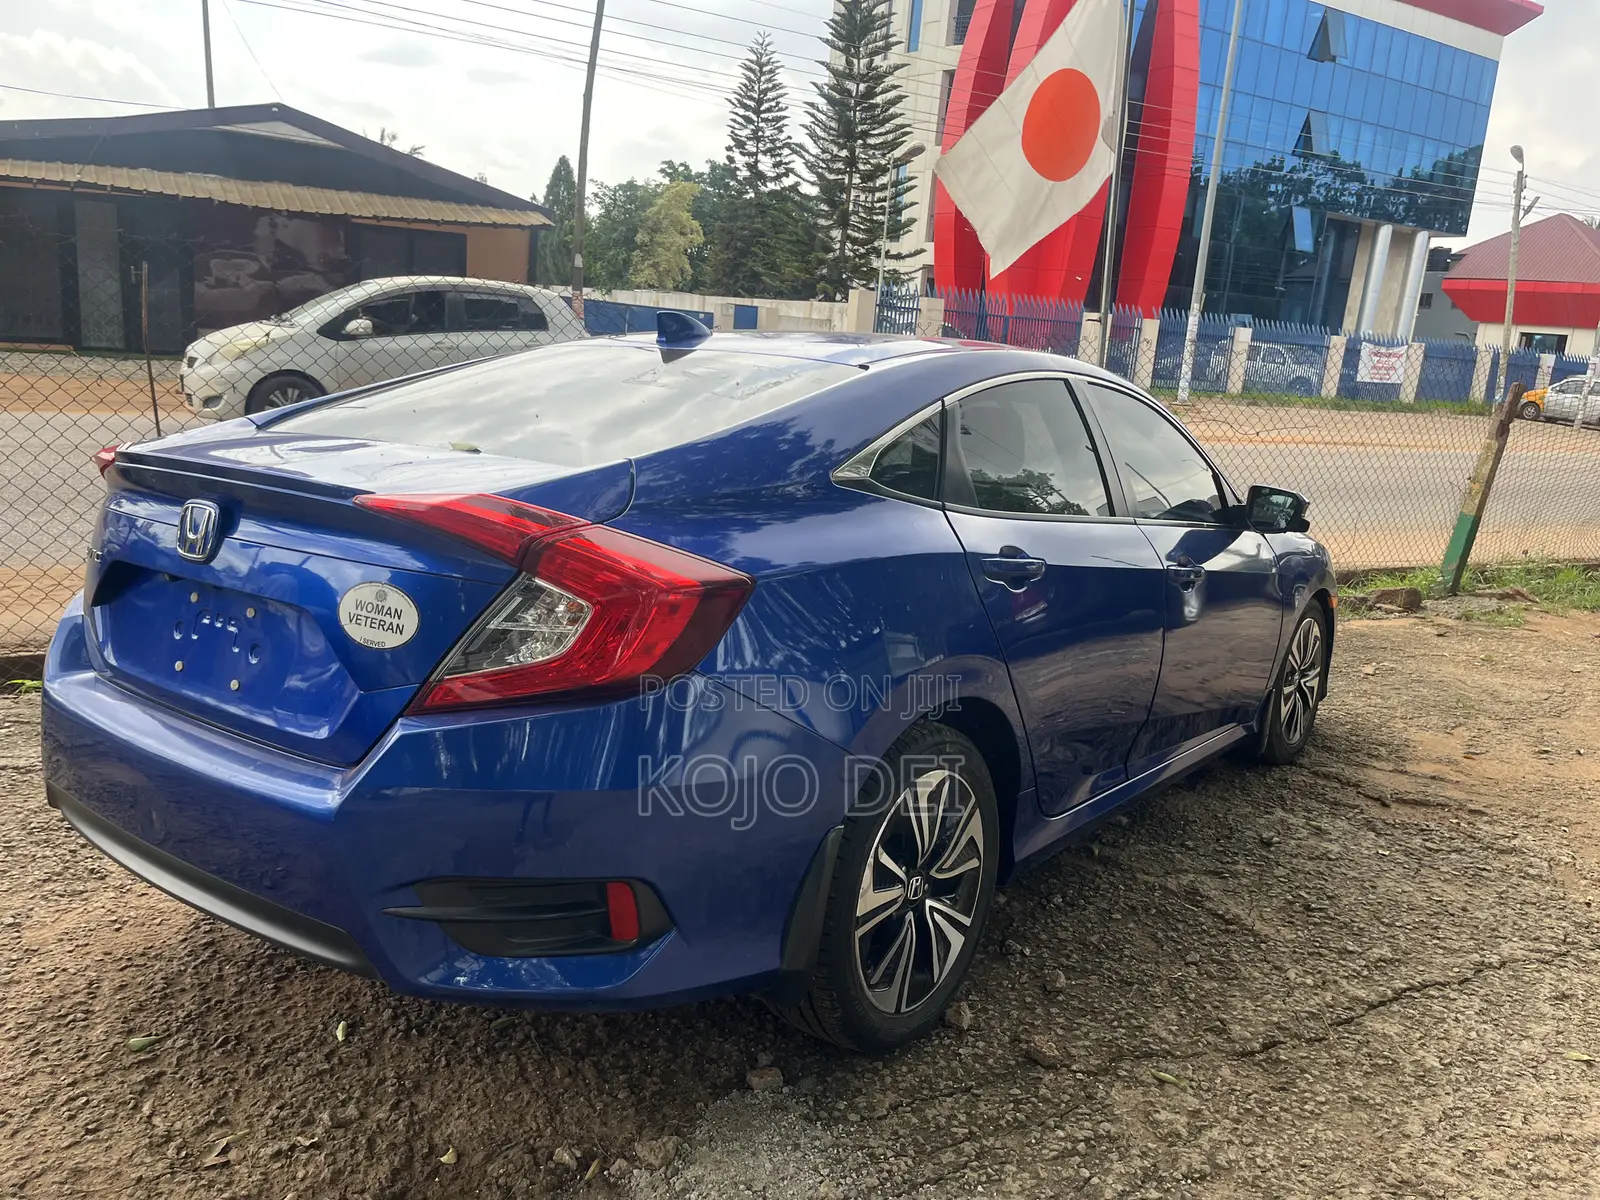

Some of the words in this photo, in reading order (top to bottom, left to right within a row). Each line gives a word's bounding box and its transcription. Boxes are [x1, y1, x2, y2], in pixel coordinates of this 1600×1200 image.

[354, 598, 403, 621] WOMAN
[348, 611, 404, 635] VETERAN
[363, 637, 386, 647] SERVED
